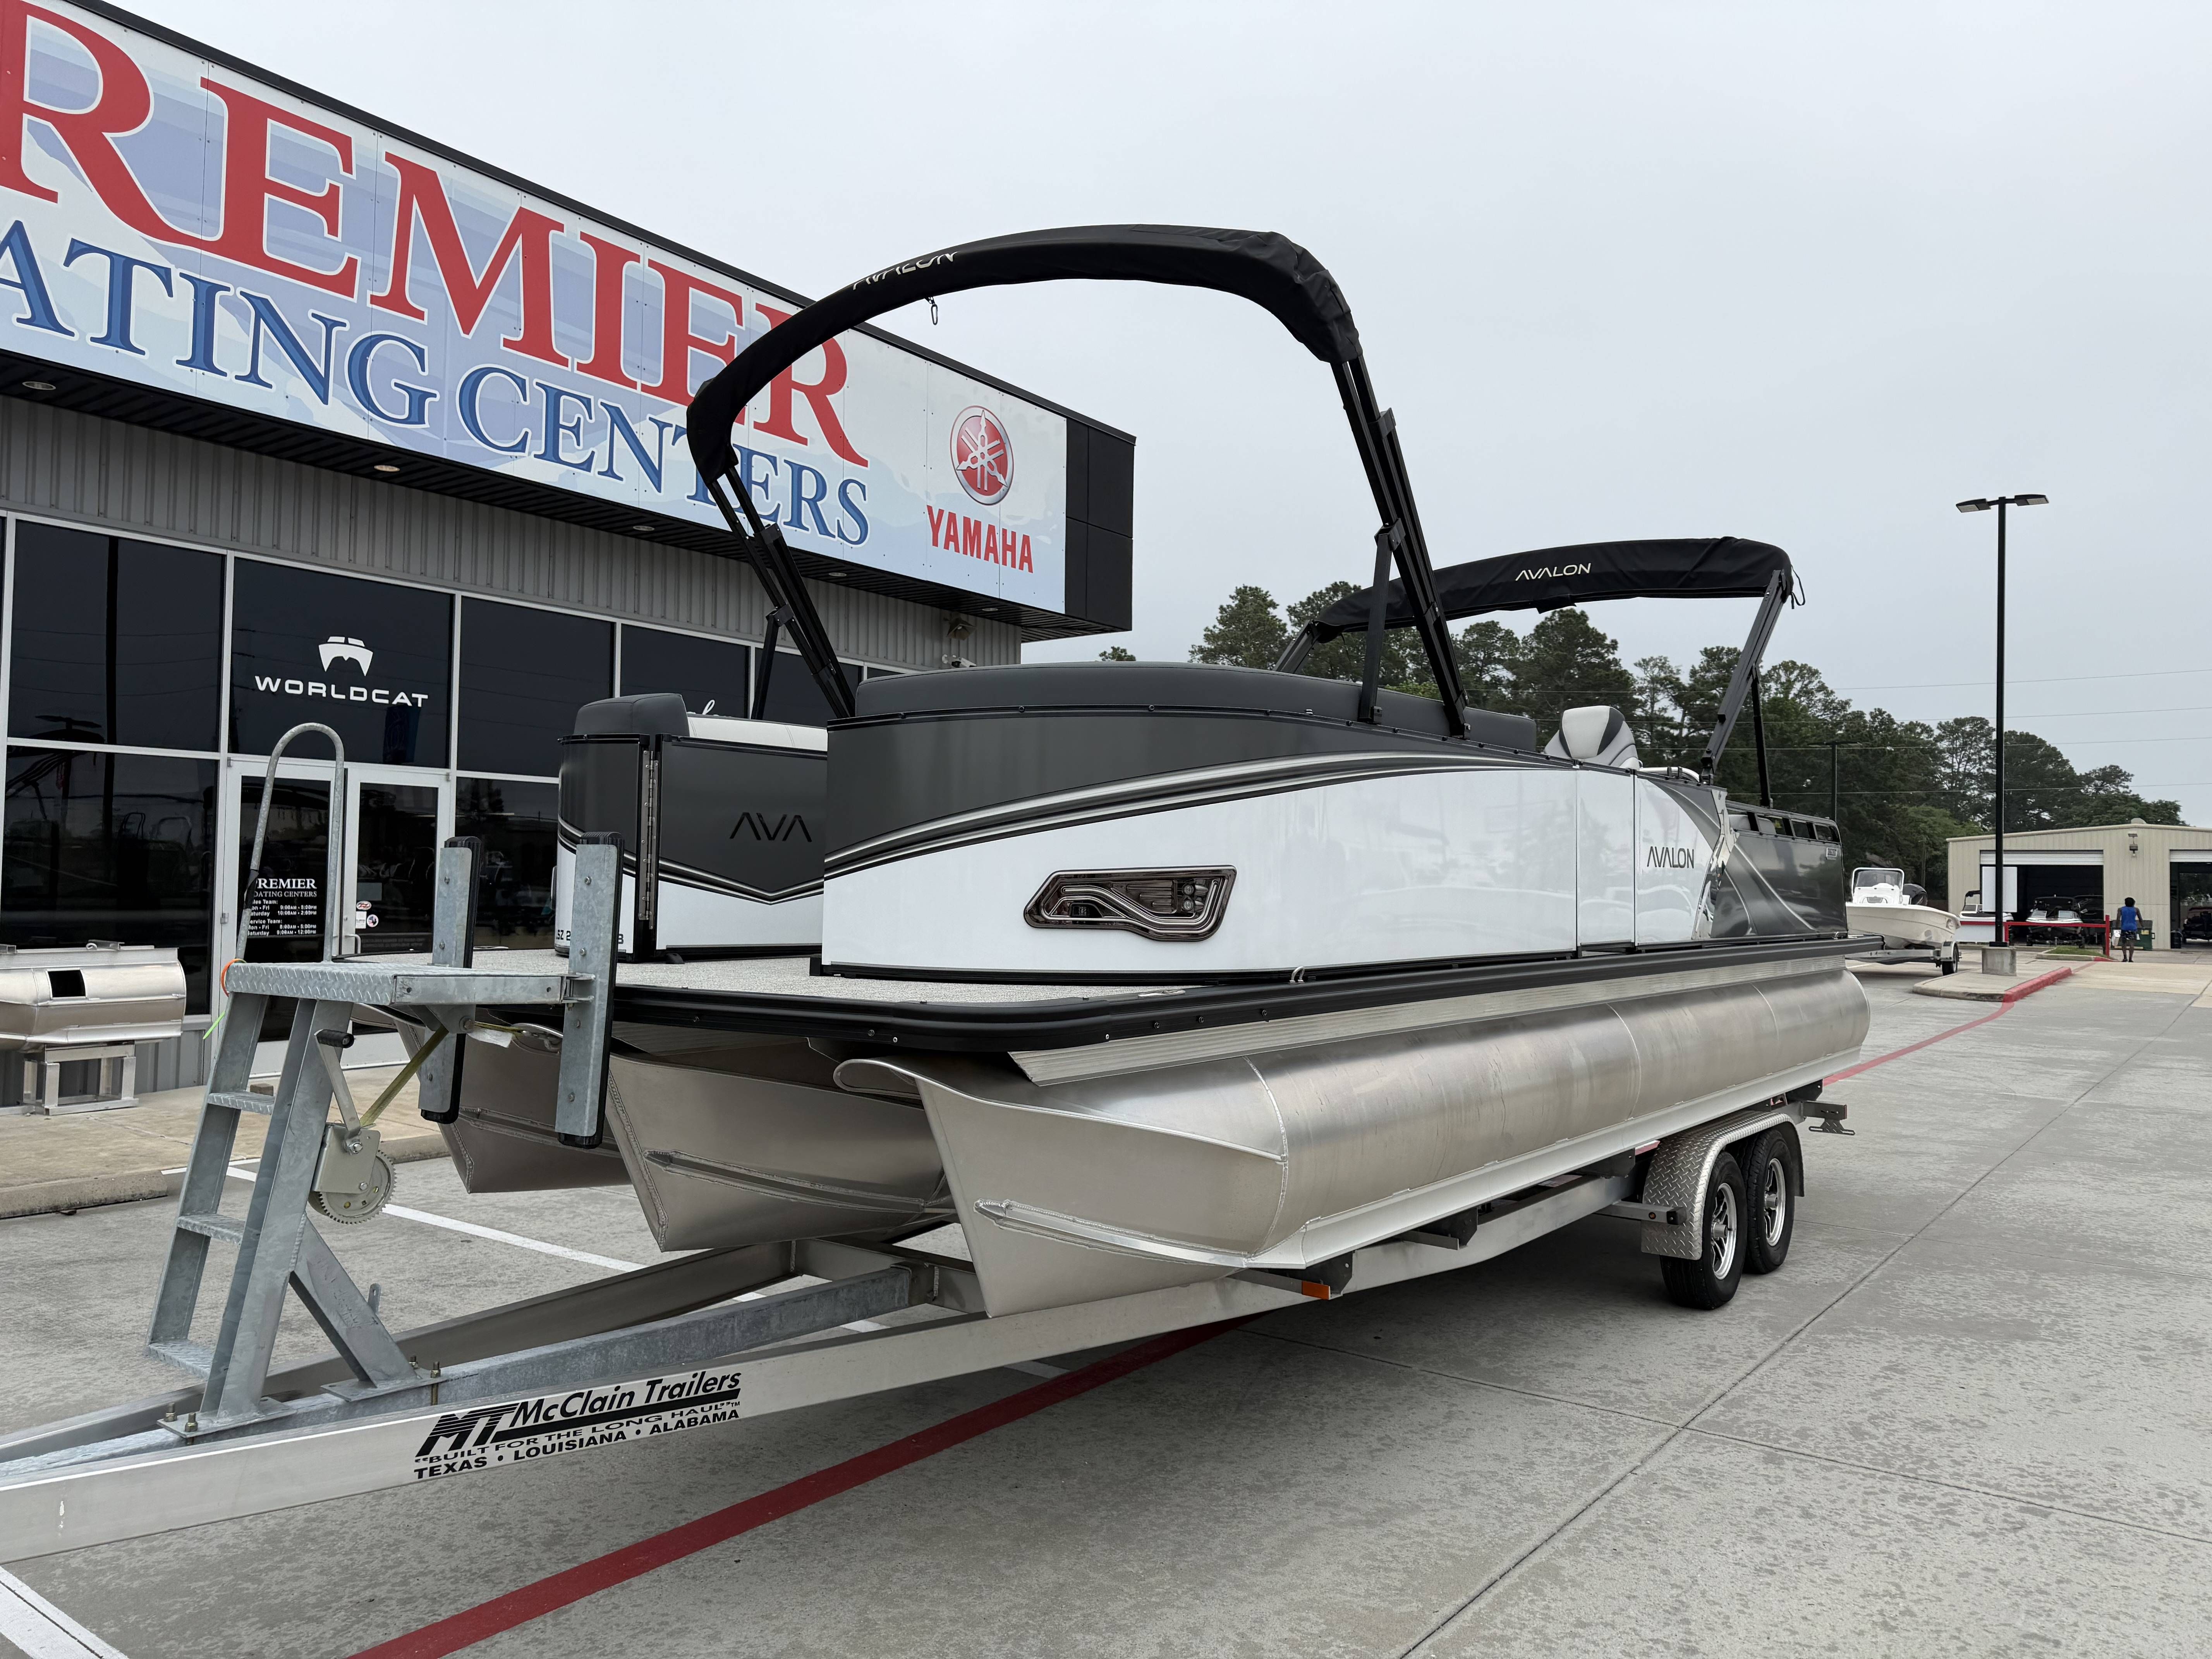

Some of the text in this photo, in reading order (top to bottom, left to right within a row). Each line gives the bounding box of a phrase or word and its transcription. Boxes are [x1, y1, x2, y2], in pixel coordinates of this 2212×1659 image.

[926, 505, 1033, 574] YAMAHA
[1515, 563, 1591, 581] AVALON
[255, 676, 428, 708] WORLDCAT
[729, 812, 812, 843] AVA
[1647, 846, 1694, 869] AVALON
[256, 878, 317, 889] REMIER
[508, 1371, 742, 1428] McClain Trailers
[414, 1409, 739, 1479] TEXAS LOUISIANA ALABAMA
[495, 1437, 539, 1451] FOR
[544, 1429, 582, 1441] THE
[591, 1415, 662, 1433] LONG
